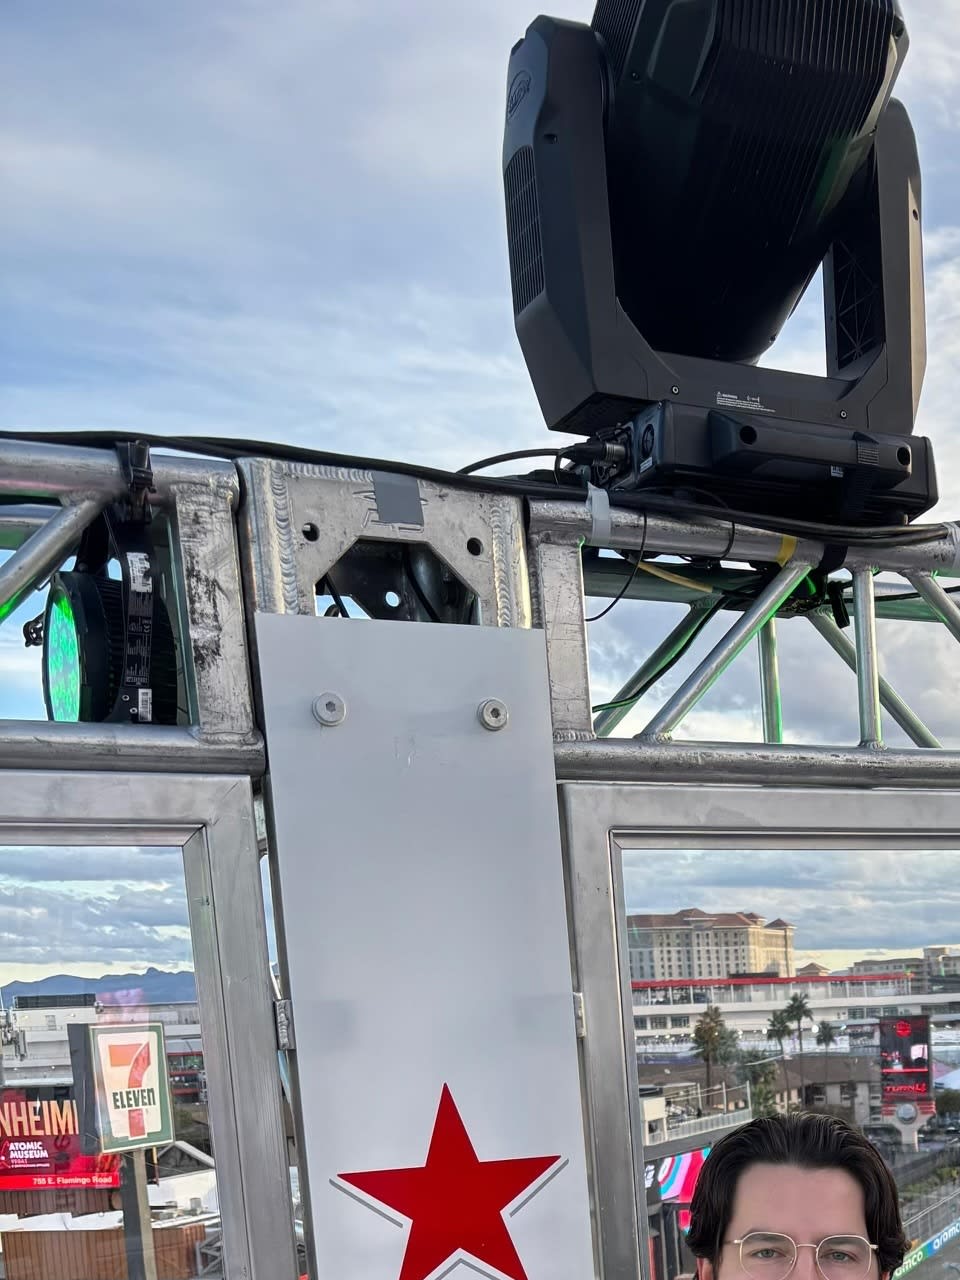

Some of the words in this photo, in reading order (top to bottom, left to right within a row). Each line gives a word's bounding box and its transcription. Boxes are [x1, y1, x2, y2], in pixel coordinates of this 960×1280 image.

[108, 1041, 151, 1138] 7
[0, 1099, 79, 1137] NHEIM
[9, 1141, 43, 1151] ATOMIC
[10, 1149, 48, 1159] MUSEUM
[57, 1176, 91, 1184] Flamingo
[92, 1175, 113, 1184] Road
